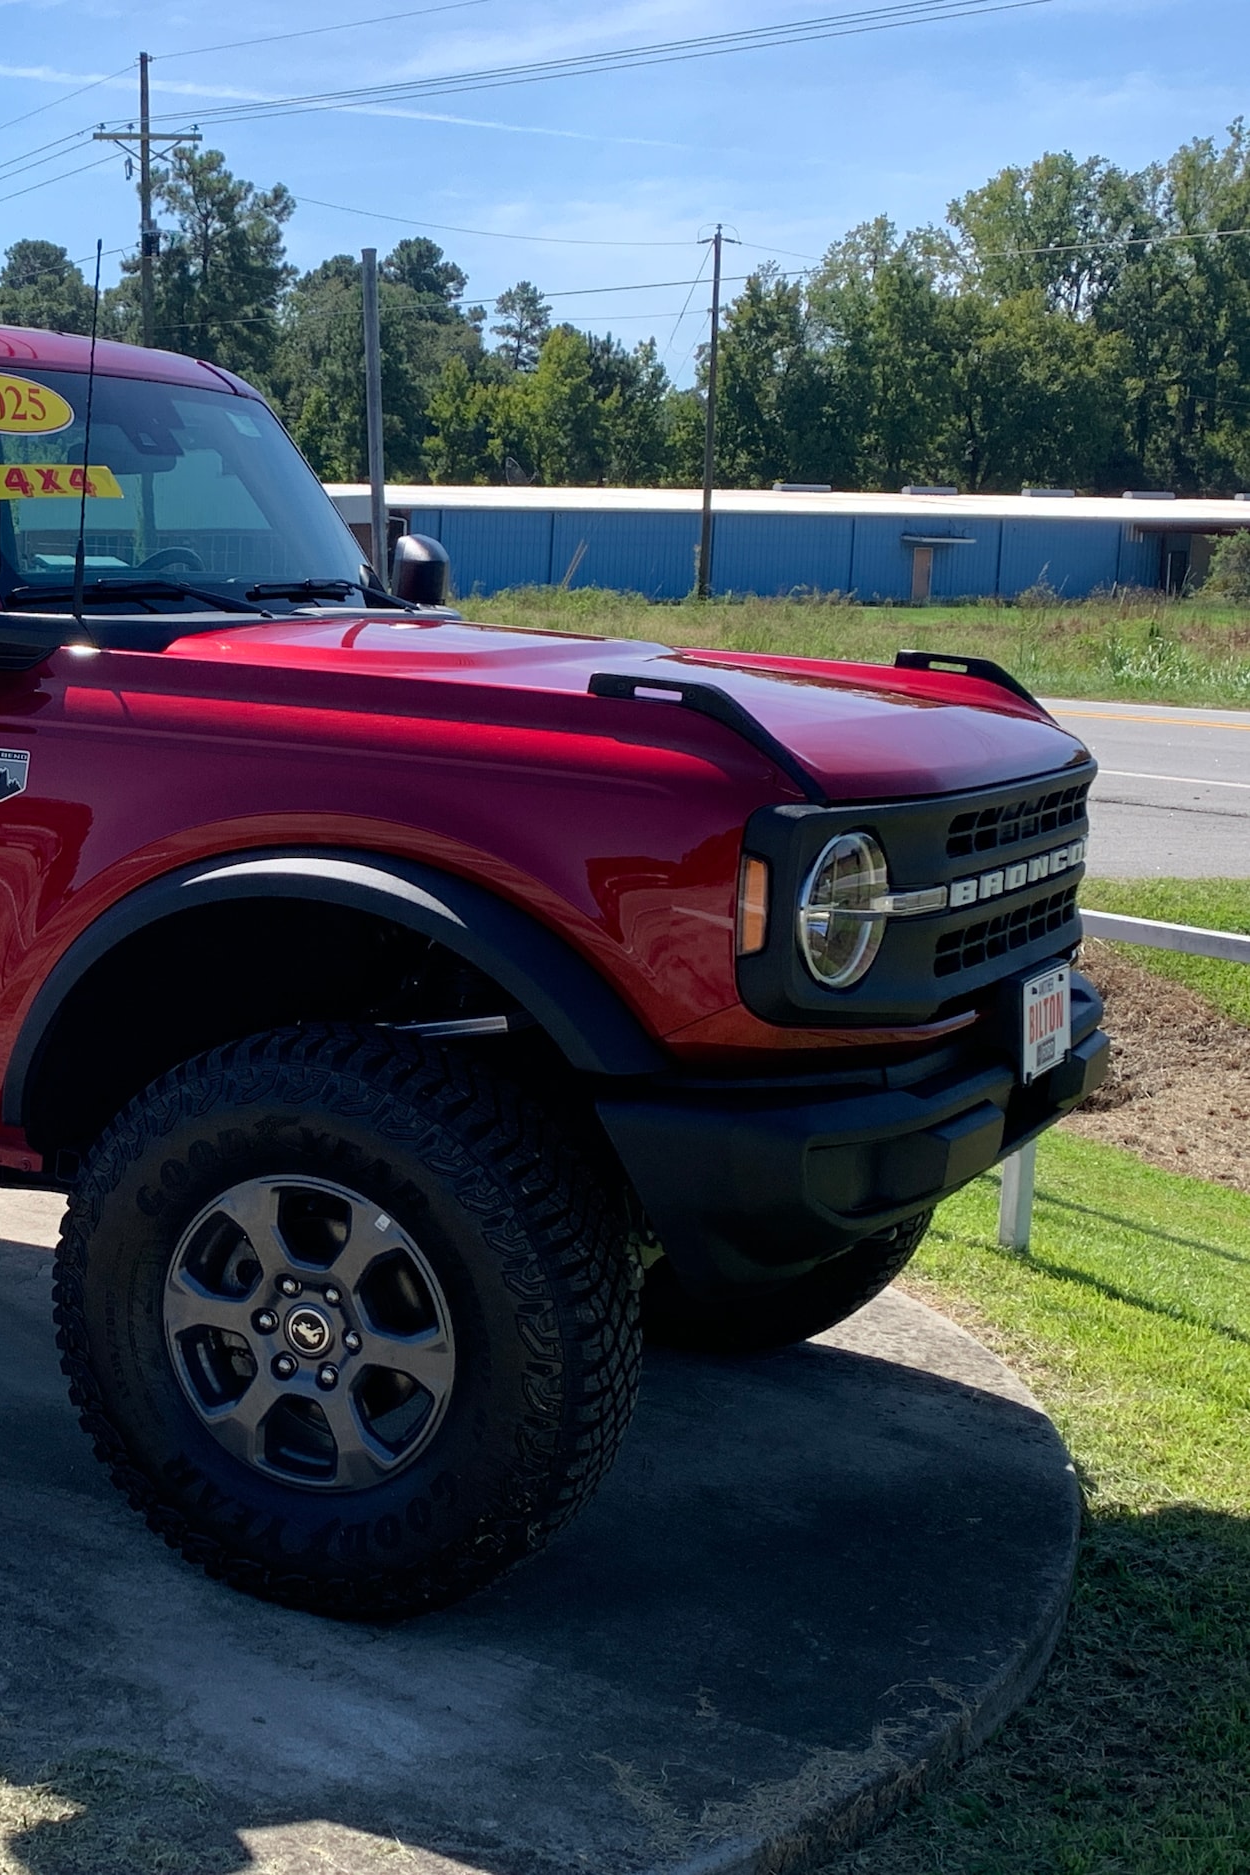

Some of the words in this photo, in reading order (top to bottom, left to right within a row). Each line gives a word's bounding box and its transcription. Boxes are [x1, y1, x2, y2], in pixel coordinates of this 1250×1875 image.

[0, 752, 28, 760] BEND
[950, 836, 1089, 908] BRONCO
[1028, 990, 1064, 1045] BILTON
